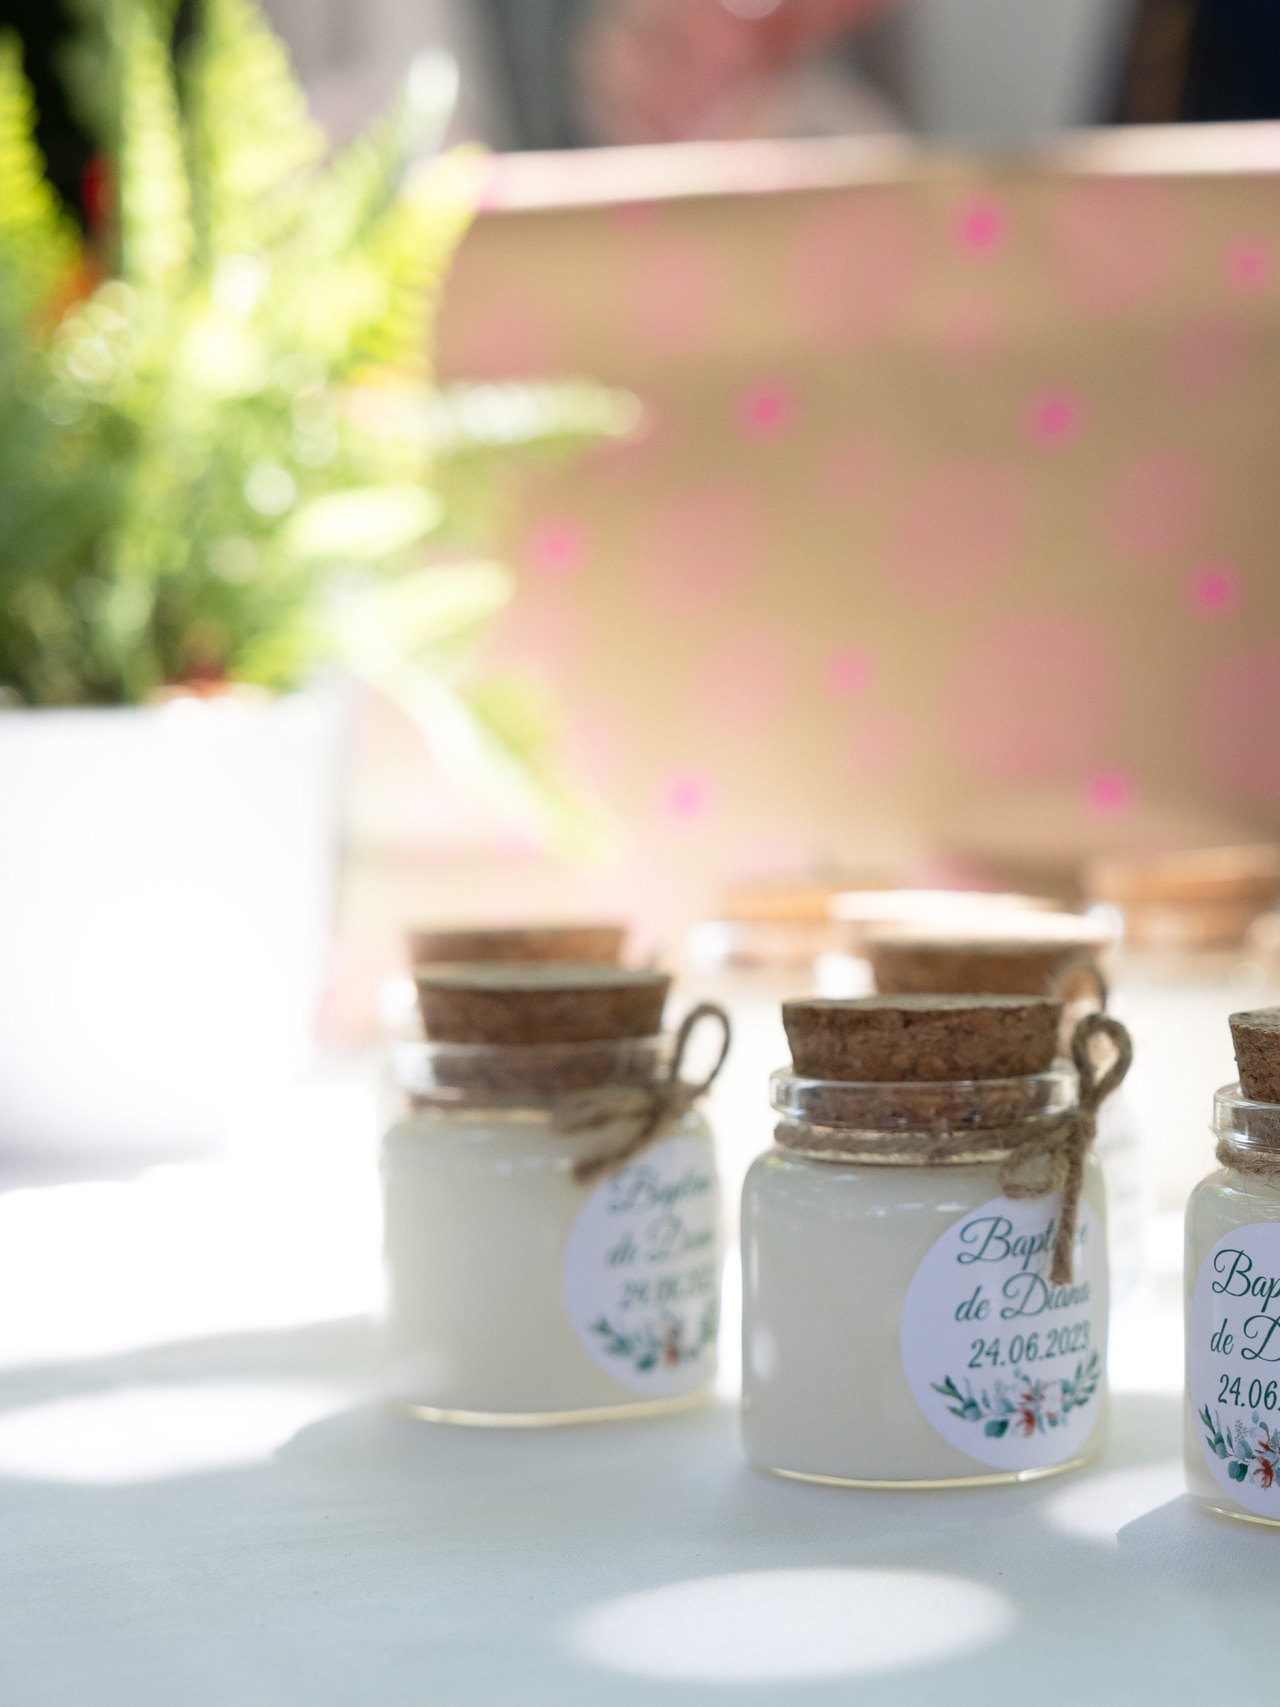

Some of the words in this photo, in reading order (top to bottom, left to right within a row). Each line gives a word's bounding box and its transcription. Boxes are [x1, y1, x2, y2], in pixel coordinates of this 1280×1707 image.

[954, 1285, 990, 1321] de
[968, 1320, 1091, 1368] 24.06.2023
[1210, 1318, 1234, 1355] de
